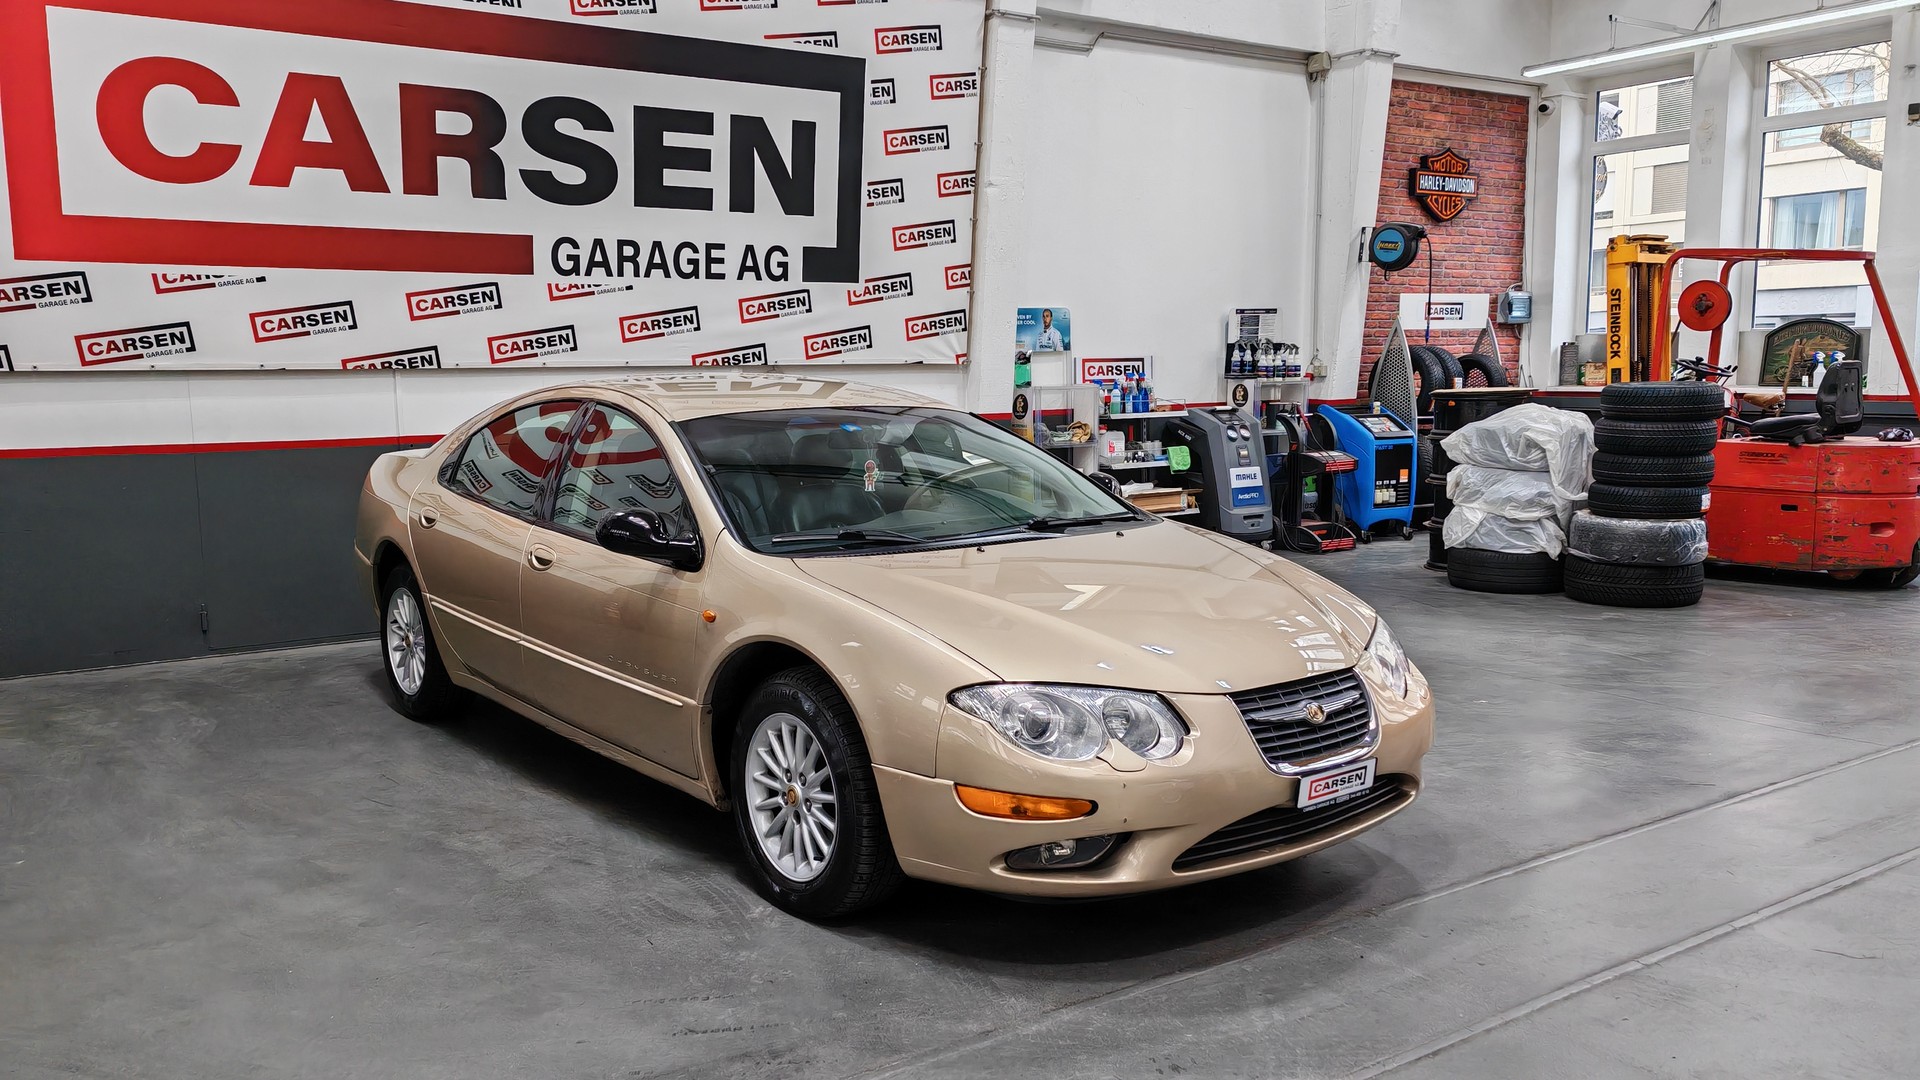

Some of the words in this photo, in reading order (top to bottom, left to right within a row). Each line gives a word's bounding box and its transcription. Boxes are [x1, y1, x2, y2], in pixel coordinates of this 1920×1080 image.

[881, 32, 937, 47] CARSEN
[95, 56, 817, 216] CARSEN
[890, 132, 945, 148] CARSEN
[1434, 159, 1463, 172] MOTOR
[1419, 175, 1475, 193] HARLEY-DAVIDSON
[1433, 195, 1461, 215] CYCLES
[898, 227, 951, 243] CARSEN
[550, 236, 726, 281] GARAGE
[737, 245, 789, 282] AG
[217, 279, 245, 288] GARAGE
[38, 300, 68, 309] GARAGE
[415, 290, 495, 312] CARSEN
[461, 306, 484, 314] GARAGE
[745, 296, 807, 316] CARSEN
[260, 309, 349, 333] CARSEN
[626, 314, 694, 334] CARSEN
[910, 315, 963, 334] CARSEN
[1610, 288, 1621, 360] STEINBOCK
[312, 327, 337, 335] GARAGE
[87, 331, 186, 356] CARSEN
[496, 333, 571, 355] CARSEN
[810, 332, 868, 352] CARSEN
[145, 350, 173, 359] GARAGE
[540, 349, 561, 357] GARAGE
[1314, 772, 1362, 793] CARSEN
